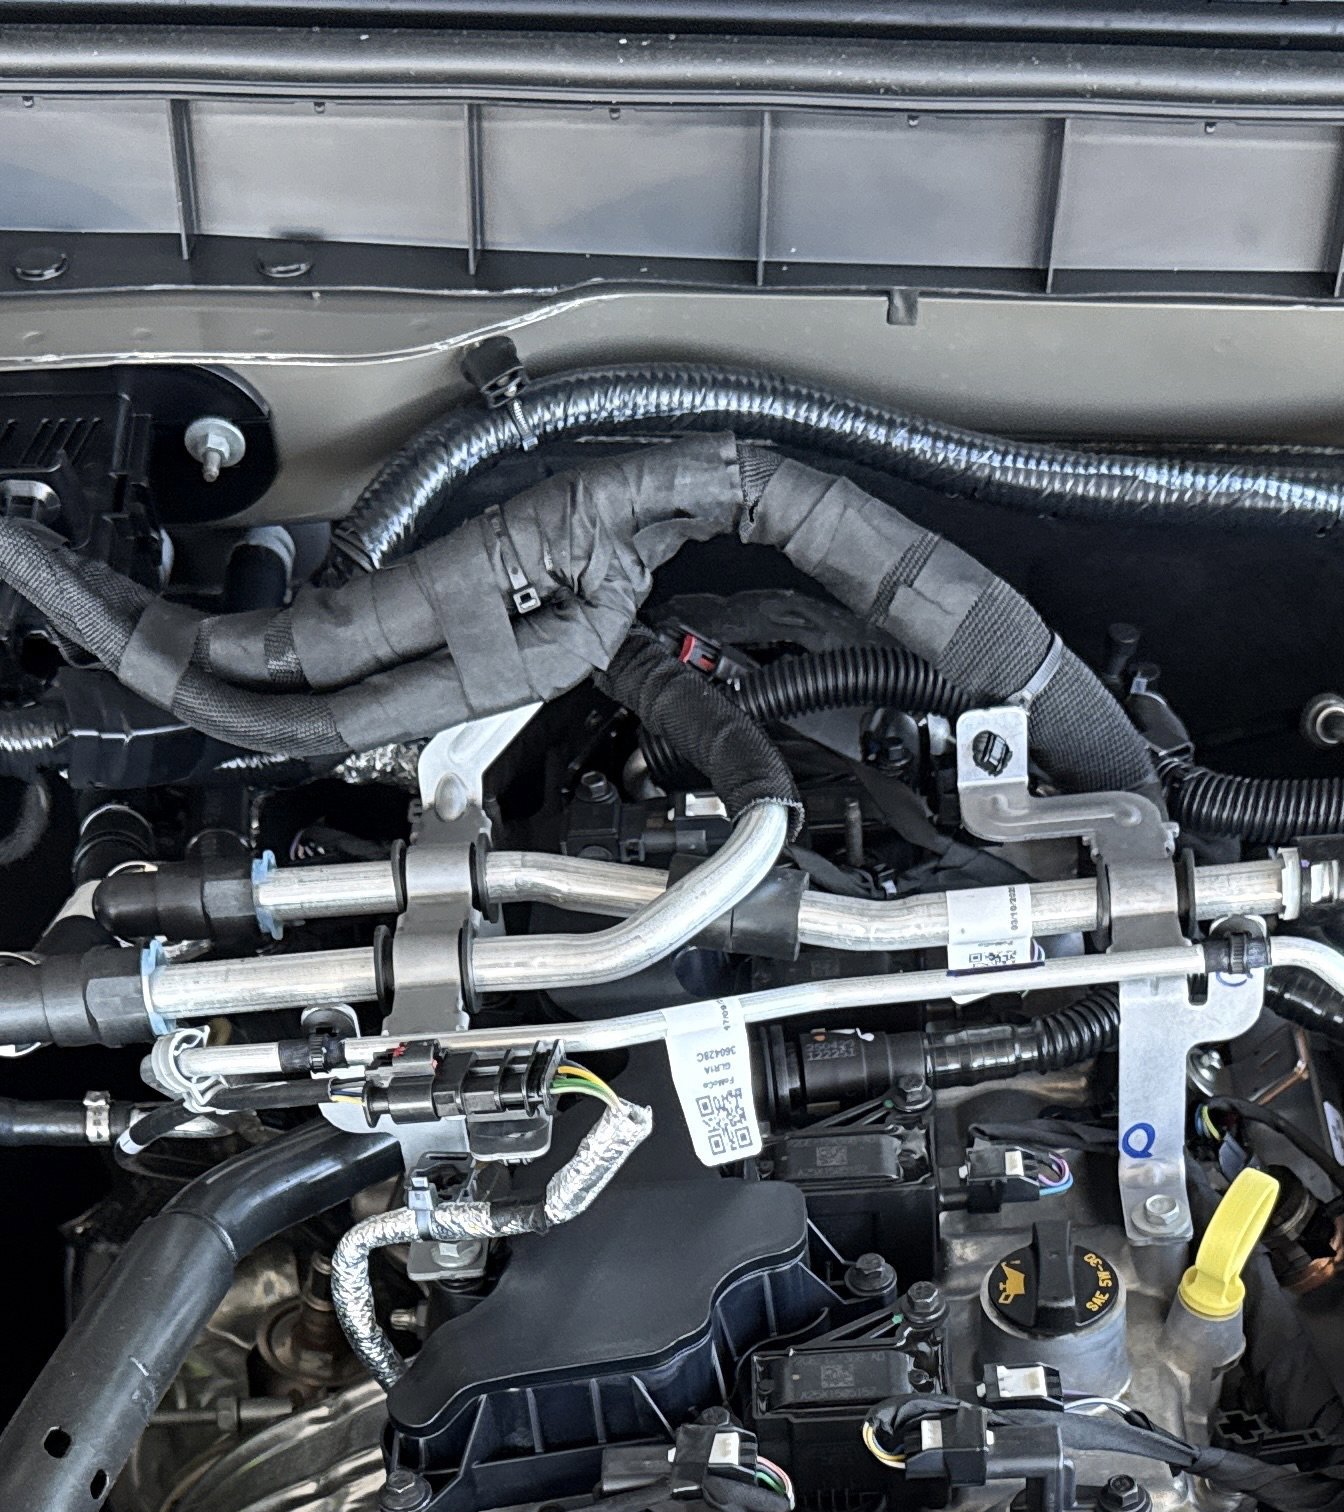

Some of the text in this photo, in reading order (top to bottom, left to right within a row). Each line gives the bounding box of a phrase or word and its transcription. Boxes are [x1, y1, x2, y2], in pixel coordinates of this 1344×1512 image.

[702, 1076, 735, 1089] FoMoCo
[1083, 1252, 1113, 1312] SAE 5W-30
